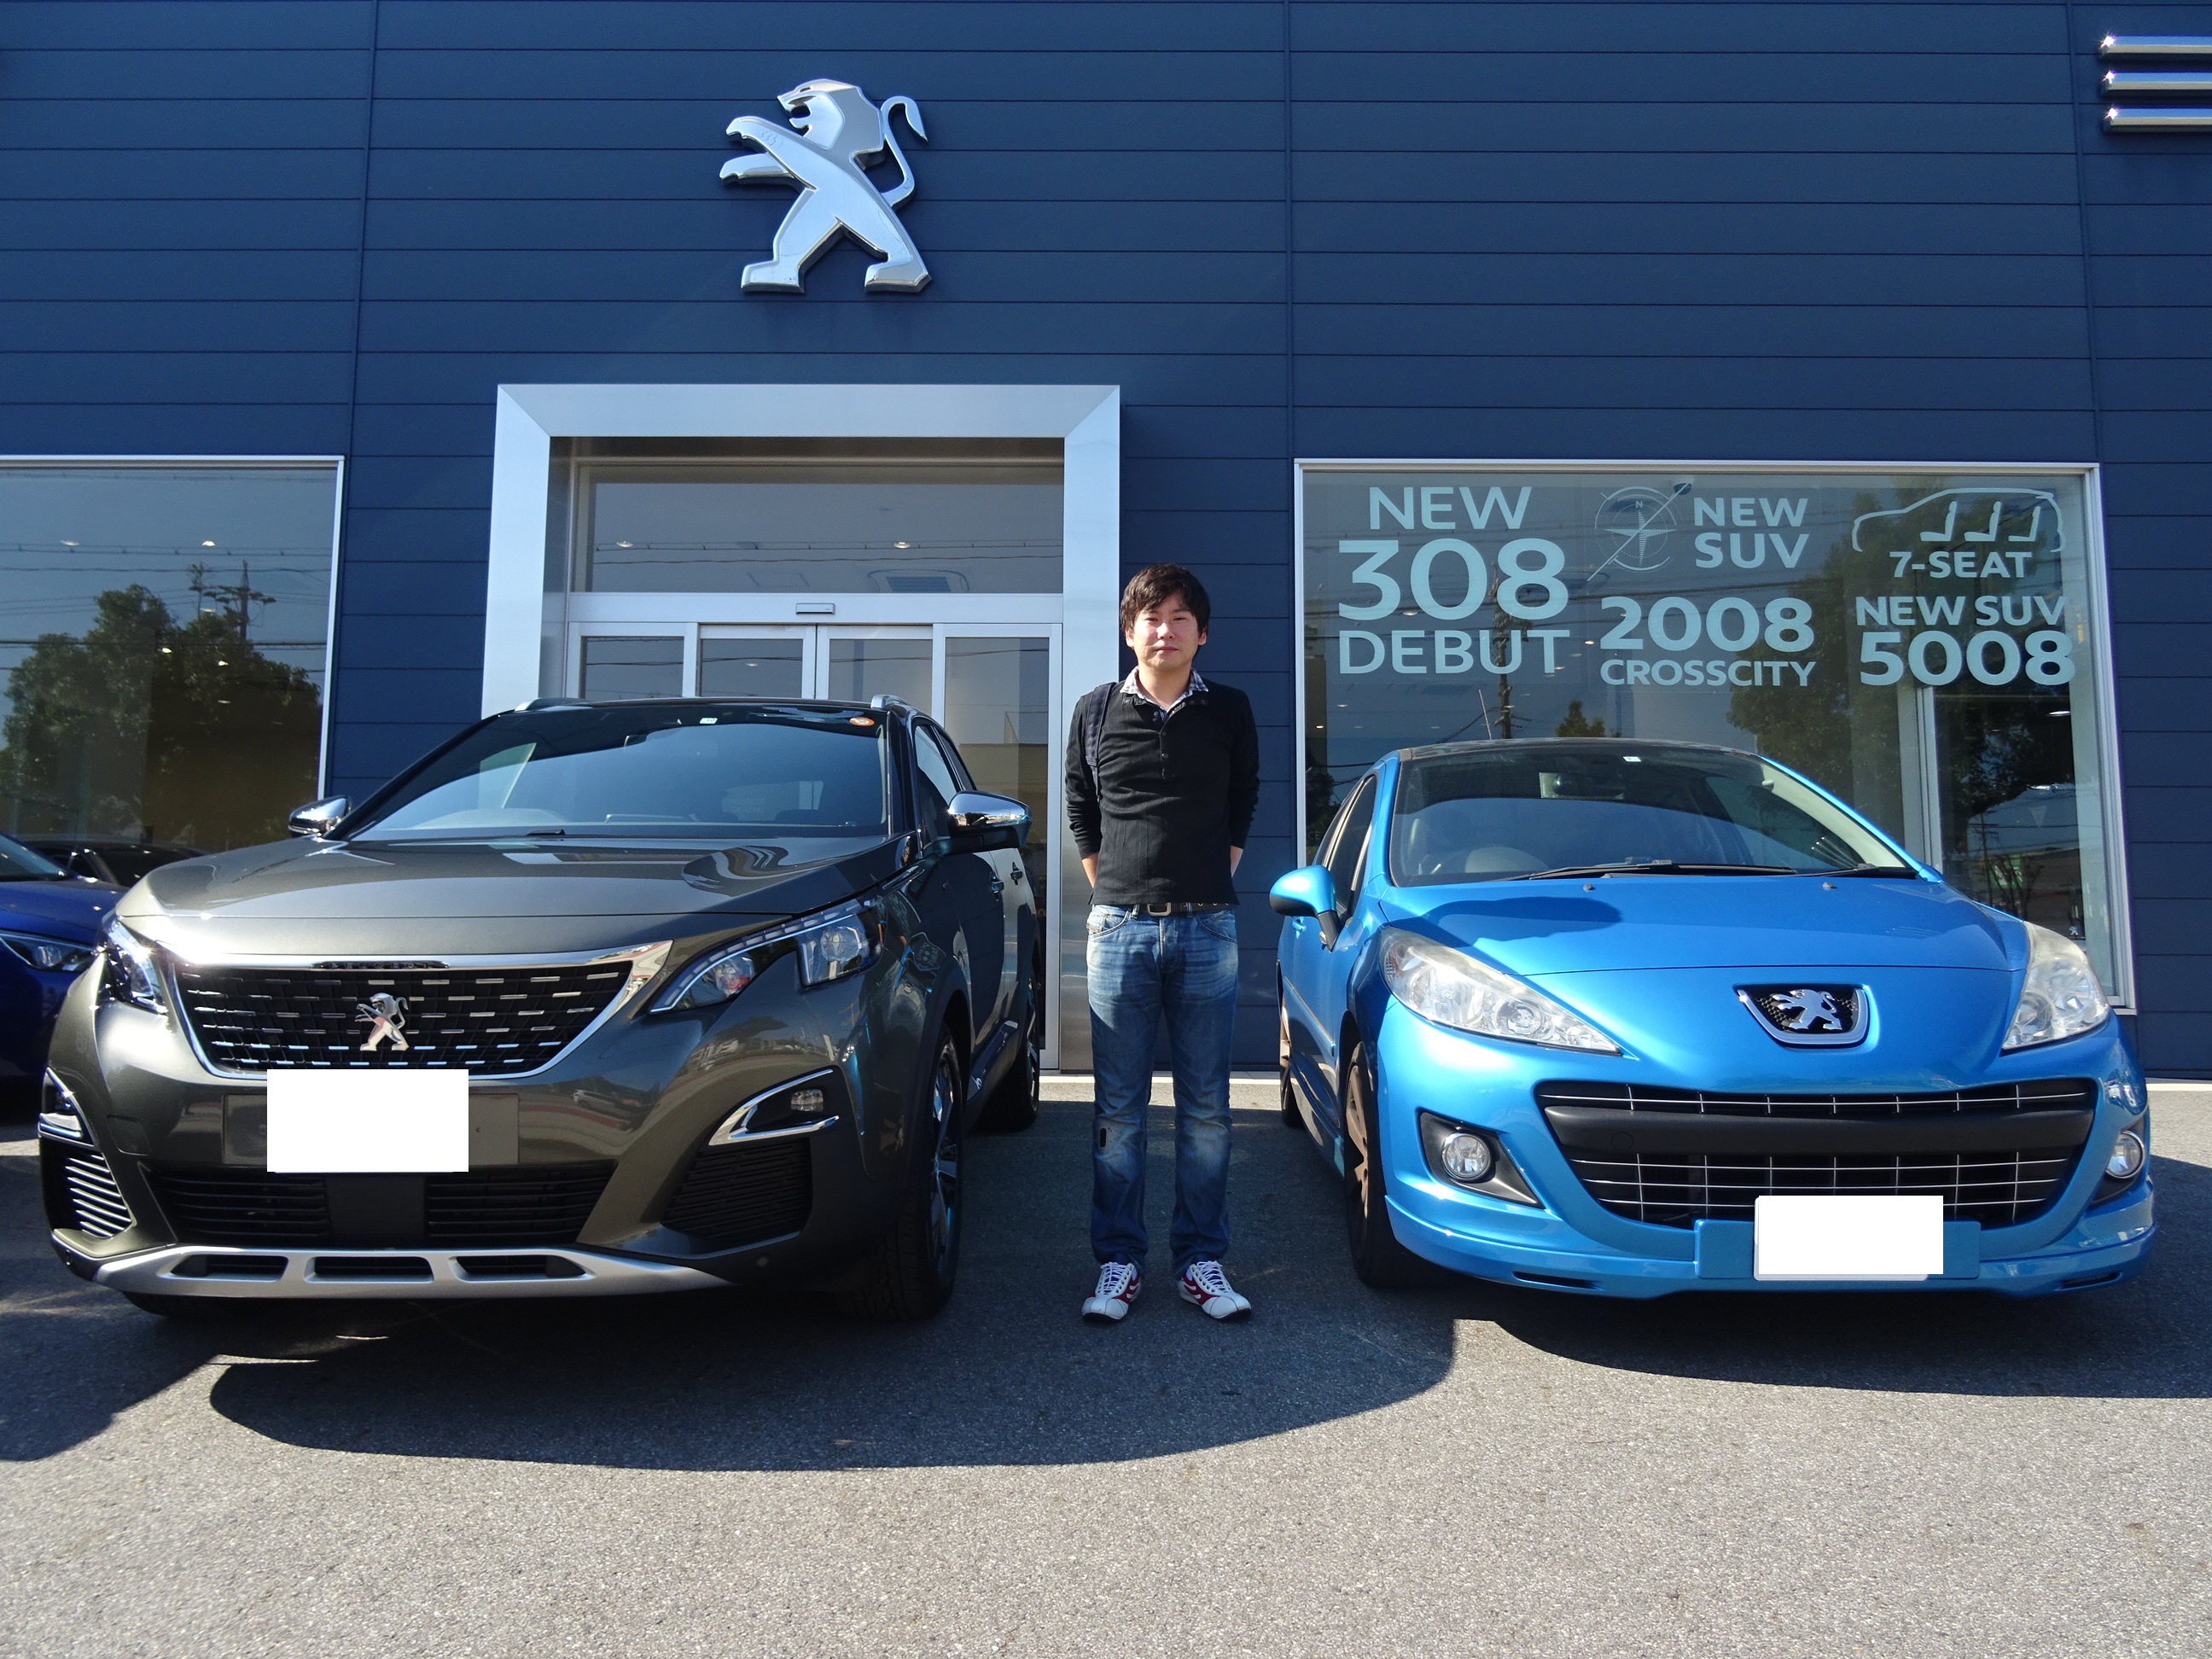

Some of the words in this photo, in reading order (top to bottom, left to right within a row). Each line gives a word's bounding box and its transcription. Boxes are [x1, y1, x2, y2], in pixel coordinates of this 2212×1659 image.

[1369, 486, 1532, 530] NEW
[1635, 500, 1644, 509] N
[1693, 498, 1808, 527] NEW
[1694, 533, 1810, 569] SUV
[1889, 551, 2033, 579] 7-SEAT
[1338, 538, 1569, 620] 308
[1599, 597, 1814, 652] 2008
[1855, 596, 1966, 626] NEW
[1975, 596, 2065, 626] SUV
[1339, 629, 1570, 674] DEBUT
[1860, 630, 2076, 685] 5008
[1600, 659, 1817, 686] CROSSCITY
